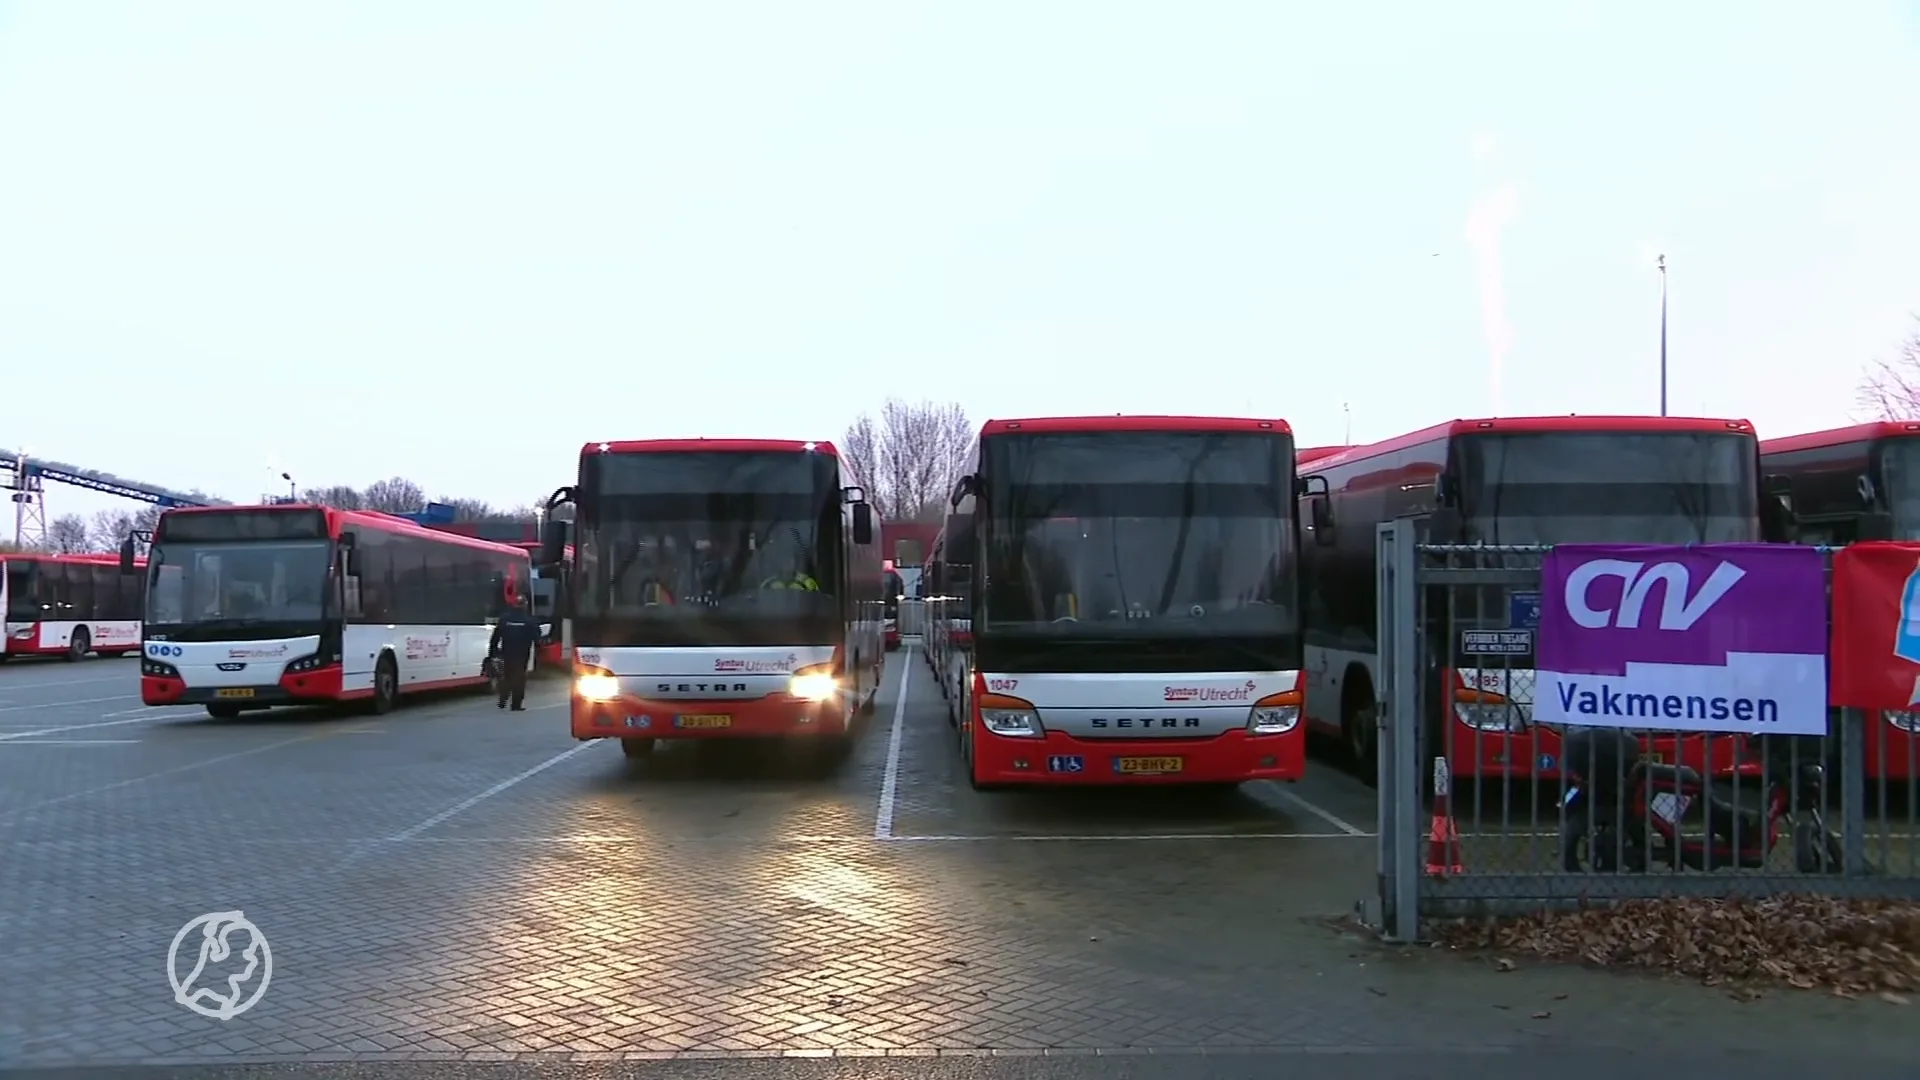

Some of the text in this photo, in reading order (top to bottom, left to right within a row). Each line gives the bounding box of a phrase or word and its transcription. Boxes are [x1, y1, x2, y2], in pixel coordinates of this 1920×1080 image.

[1564, 558, 1747, 631] CNV
[714, 658, 791, 672] Syntus Utrecht
[656, 683, 747, 693] SETRA
[989, 678, 1019, 692] 1047
[1163, 685, 1249, 701] Syntus Utrecht
[1557, 680, 1779, 723] Vakmensen
[1091, 717, 1200, 729] SETRA
[1122, 757, 1179, 772] 23-BHV-2
